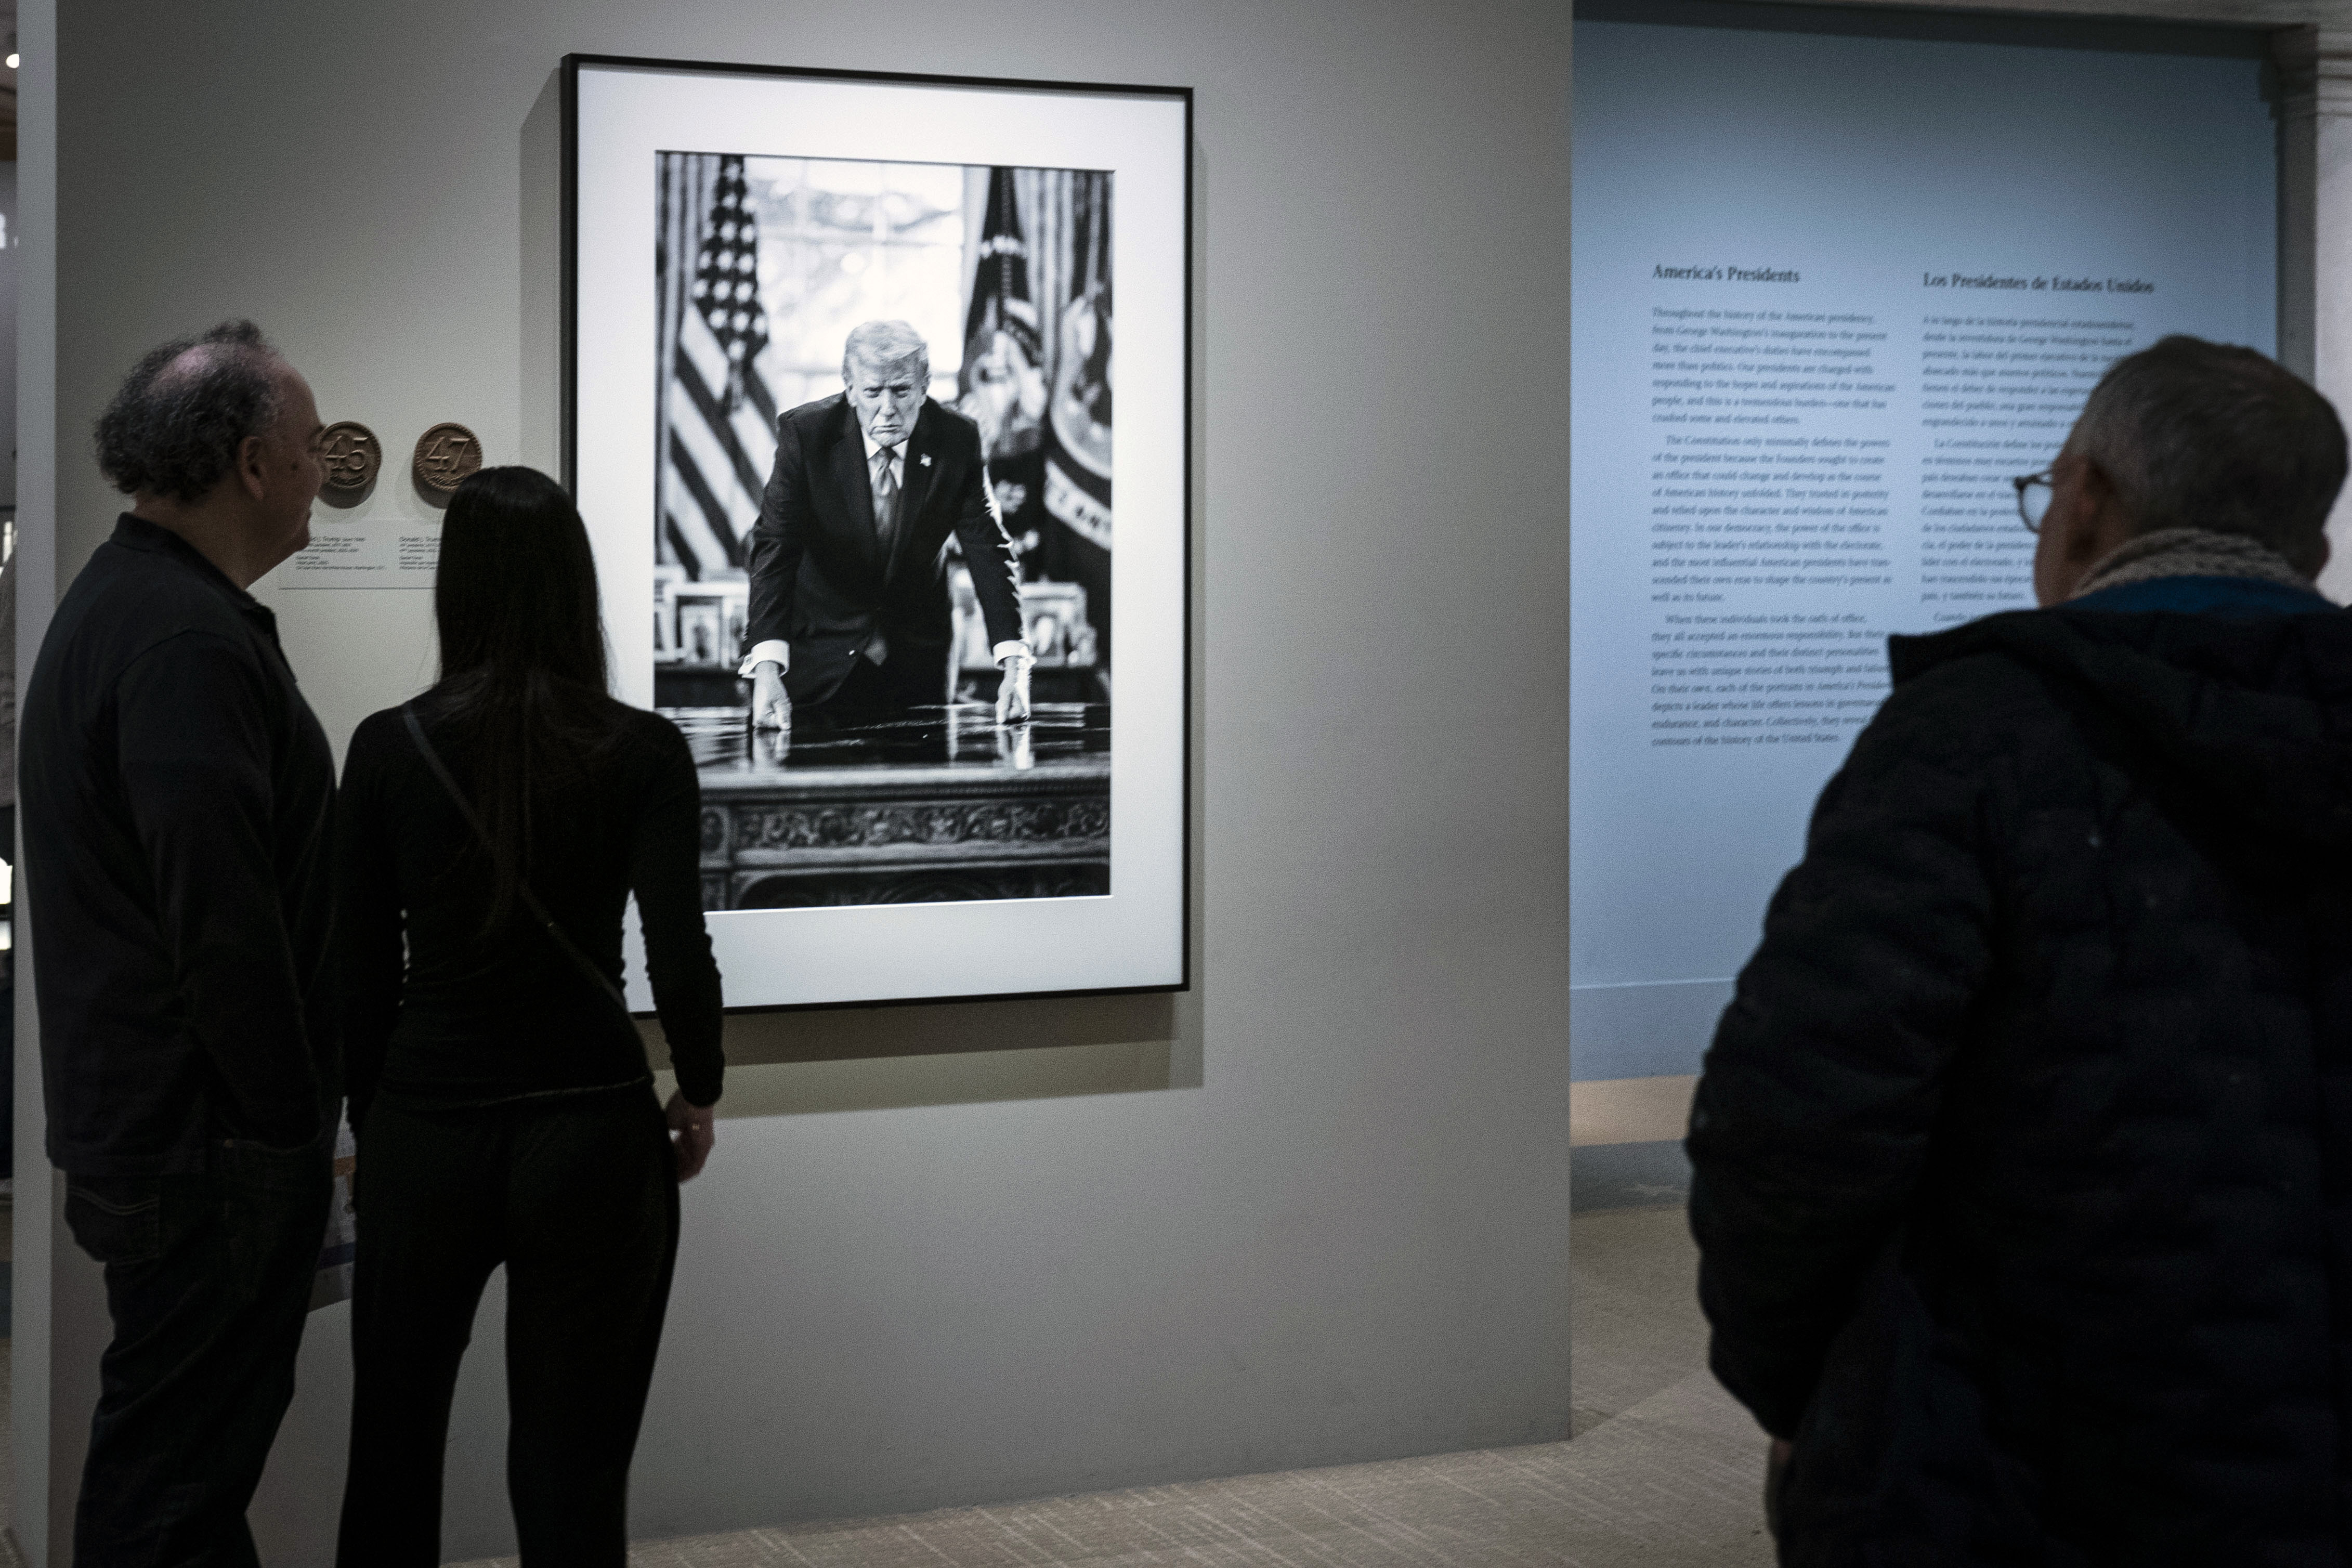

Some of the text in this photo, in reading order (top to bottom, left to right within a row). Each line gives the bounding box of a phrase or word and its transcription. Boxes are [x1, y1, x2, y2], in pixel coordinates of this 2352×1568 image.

[1652, 264, 1800, 283] America's Presidents
[1923, 272, 2154, 295] Los Presidentes de Estados Unidos
[324, 435, 369, 472] 45
[425, 435, 471, 473] 47
